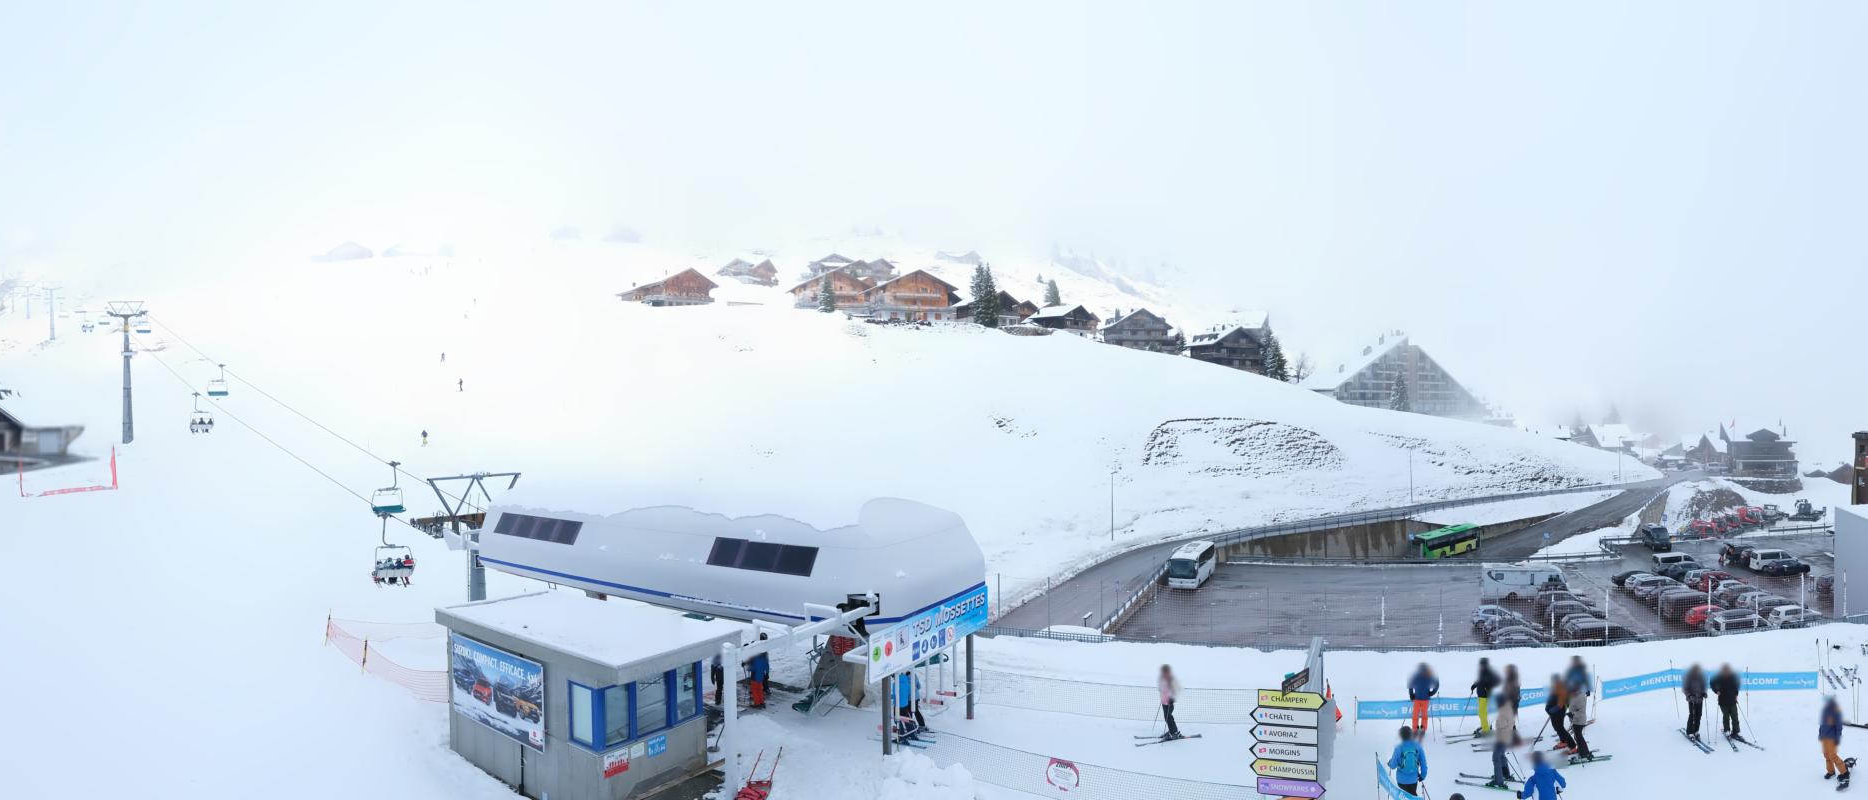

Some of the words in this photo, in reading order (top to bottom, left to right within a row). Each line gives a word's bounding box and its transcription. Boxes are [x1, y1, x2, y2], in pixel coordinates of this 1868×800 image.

[912, 616, 932, 638] TSD
[934, 592, 985, 628] MOSSETTES
[1271, 695, 1308, 704] CHAMPERY
[1269, 713, 1295, 721] CHÂTEL
[1268, 730, 1298, 739] AVORIAZ
[1268, 748, 1301, 757] MORGINS
[1269, 765, 1315, 776] CHAMPOUSSIN
[1270, 783, 1310, 793] SNOWPARKS
